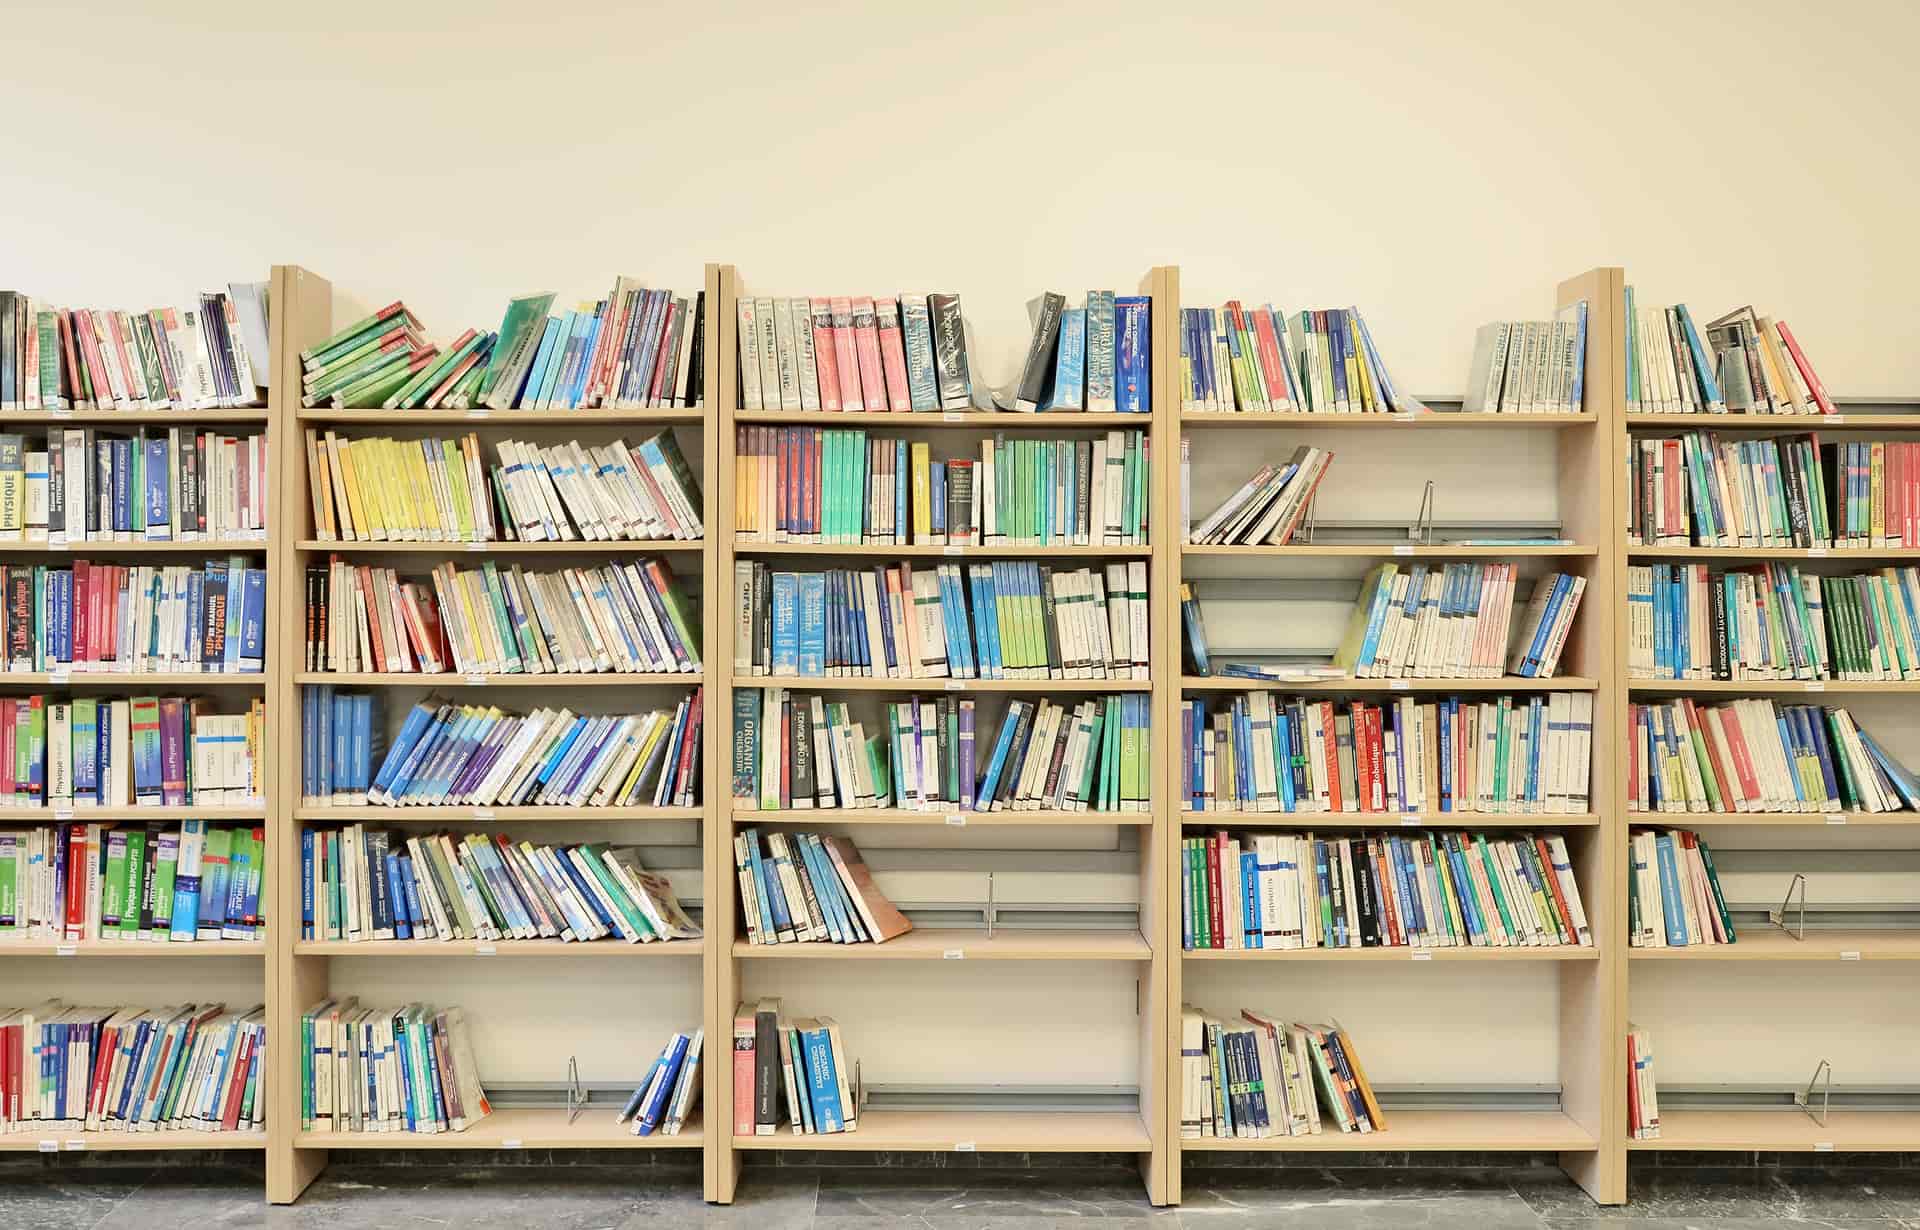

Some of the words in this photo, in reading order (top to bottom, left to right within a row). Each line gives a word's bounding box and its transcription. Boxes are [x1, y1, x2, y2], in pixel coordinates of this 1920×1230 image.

[4, 474, 15, 527] PHYSIQUE
[208, 594, 216, 626] MANUEL
[215, 594, 225, 650] PHYSIQUE
[1719, 632, 1727, 670] INTRODUCTION
[744, 720, 754, 773] ORGANIC
[1371, 741, 1380, 784] Robotique
[56, 760, 64, 794] Physique
[818, 1044, 831, 1080] ORGANIC
